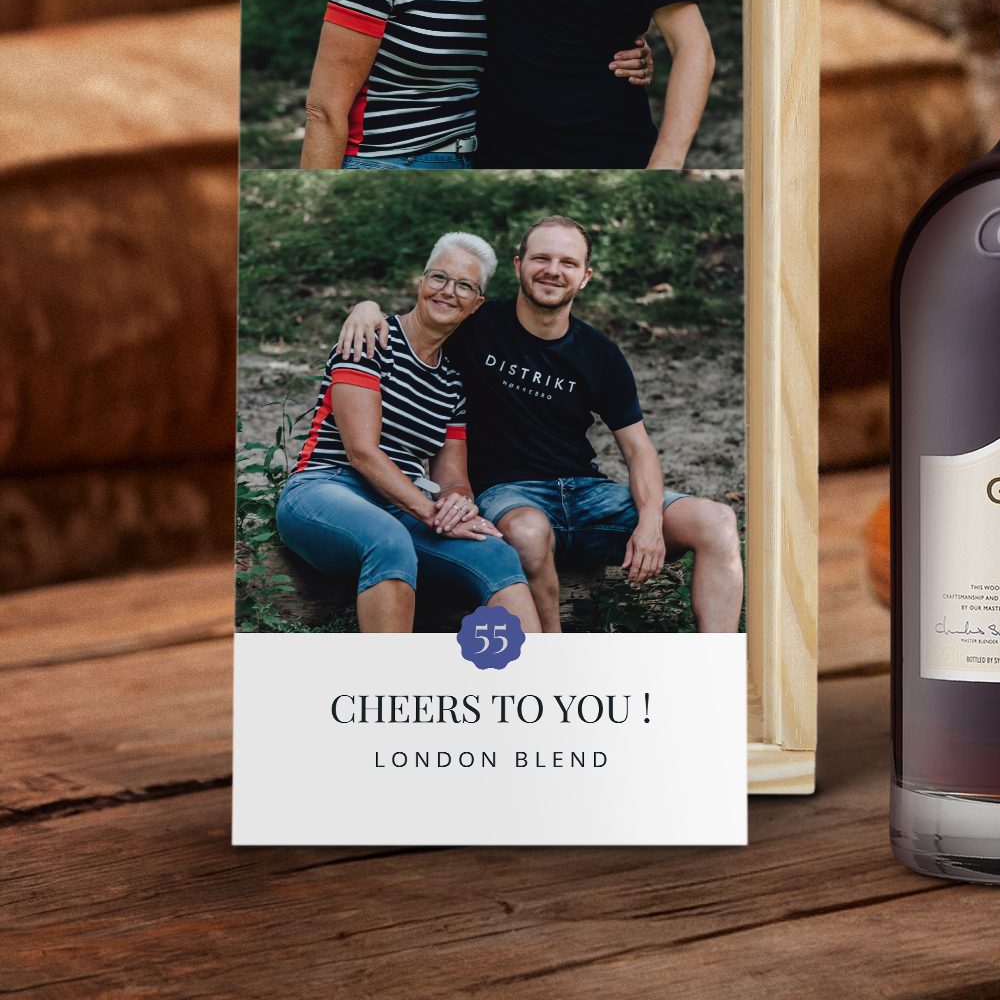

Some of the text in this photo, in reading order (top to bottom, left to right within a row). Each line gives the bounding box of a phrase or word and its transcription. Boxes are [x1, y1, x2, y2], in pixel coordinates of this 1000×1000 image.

[485, 354, 577, 393] DISTRIKT
[942, 593, 985, 601] CRAFTSMANSHIP
[473, 623, 509, 655] 55
[331, 694, 481, 724] CHEERS
[491, 694, 544, 724] TO
[553, 694, 632, 724] YOU
[375, 751, 607, 768] LONDON BLEND
